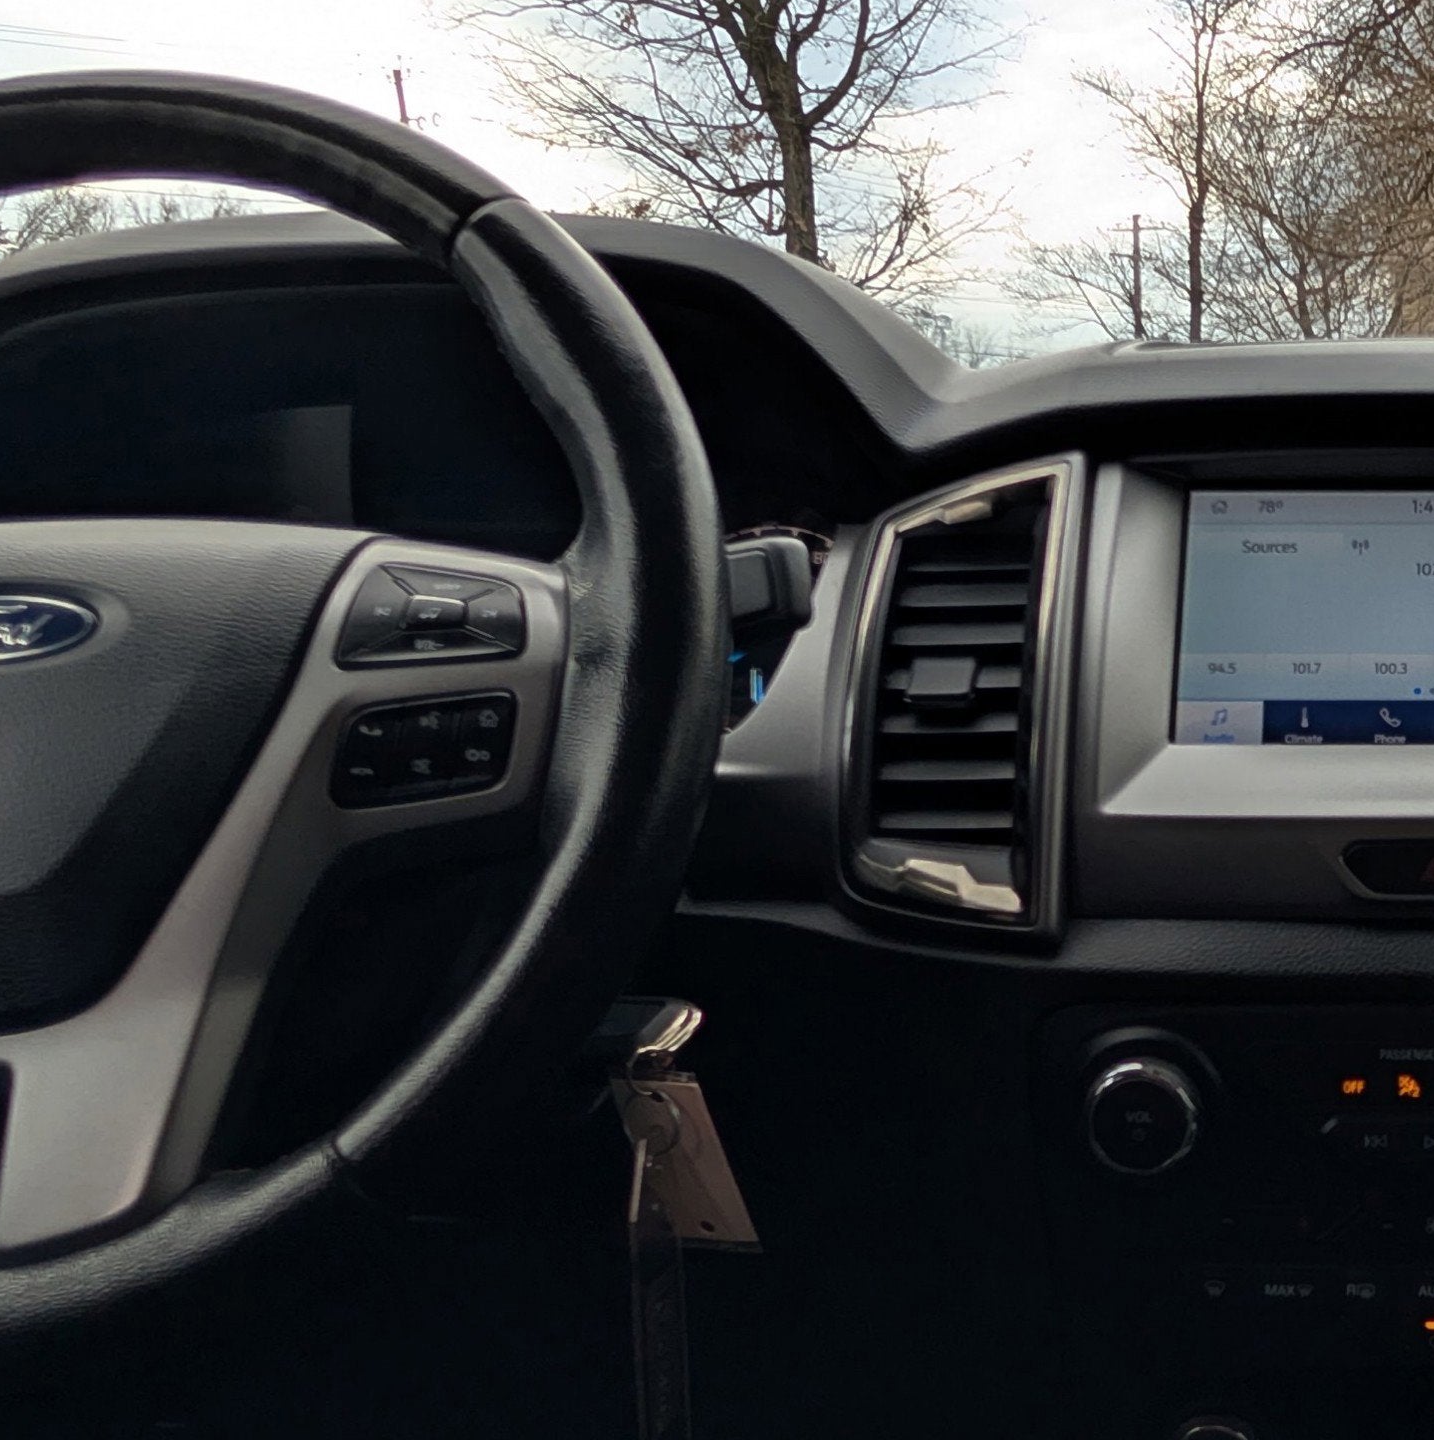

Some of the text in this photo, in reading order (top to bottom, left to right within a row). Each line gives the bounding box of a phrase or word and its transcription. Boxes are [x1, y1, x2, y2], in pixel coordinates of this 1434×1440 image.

[1242, 540, 1298, 554] Sources
[1292, 662, 1321, 675] 101.7
[1374, 662, 1408, 675] 100.3
[1284, 734, 1323, 744] Climate
[1374, 734, 1406, 744] Phone
[1342, 1078, 1367, 1095] OFF
[1264, 1284, 1295, 1297] MAX
